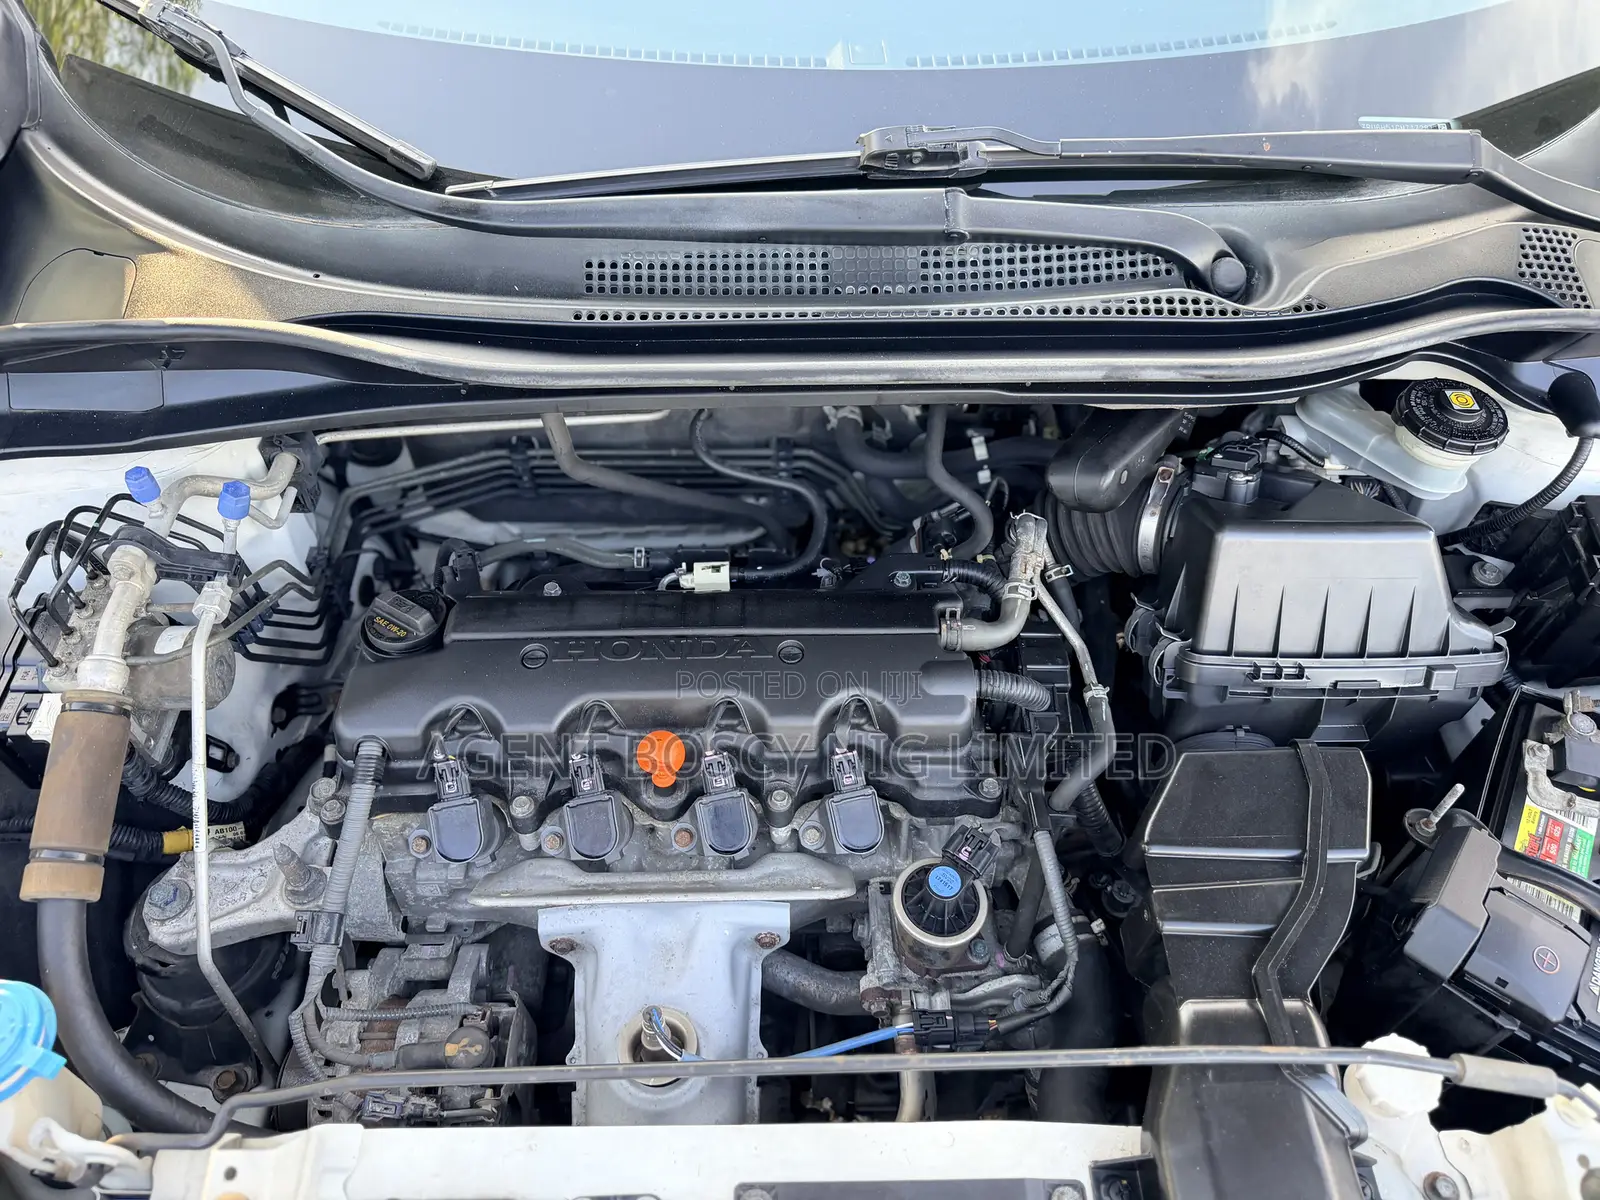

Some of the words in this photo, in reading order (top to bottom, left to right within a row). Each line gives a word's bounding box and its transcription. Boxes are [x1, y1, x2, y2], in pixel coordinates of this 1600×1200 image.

[373, 616, 389, 627] SAE
[387, 623, 407, 638] 0W-20
[552, 640, 774, 662] HONDA
